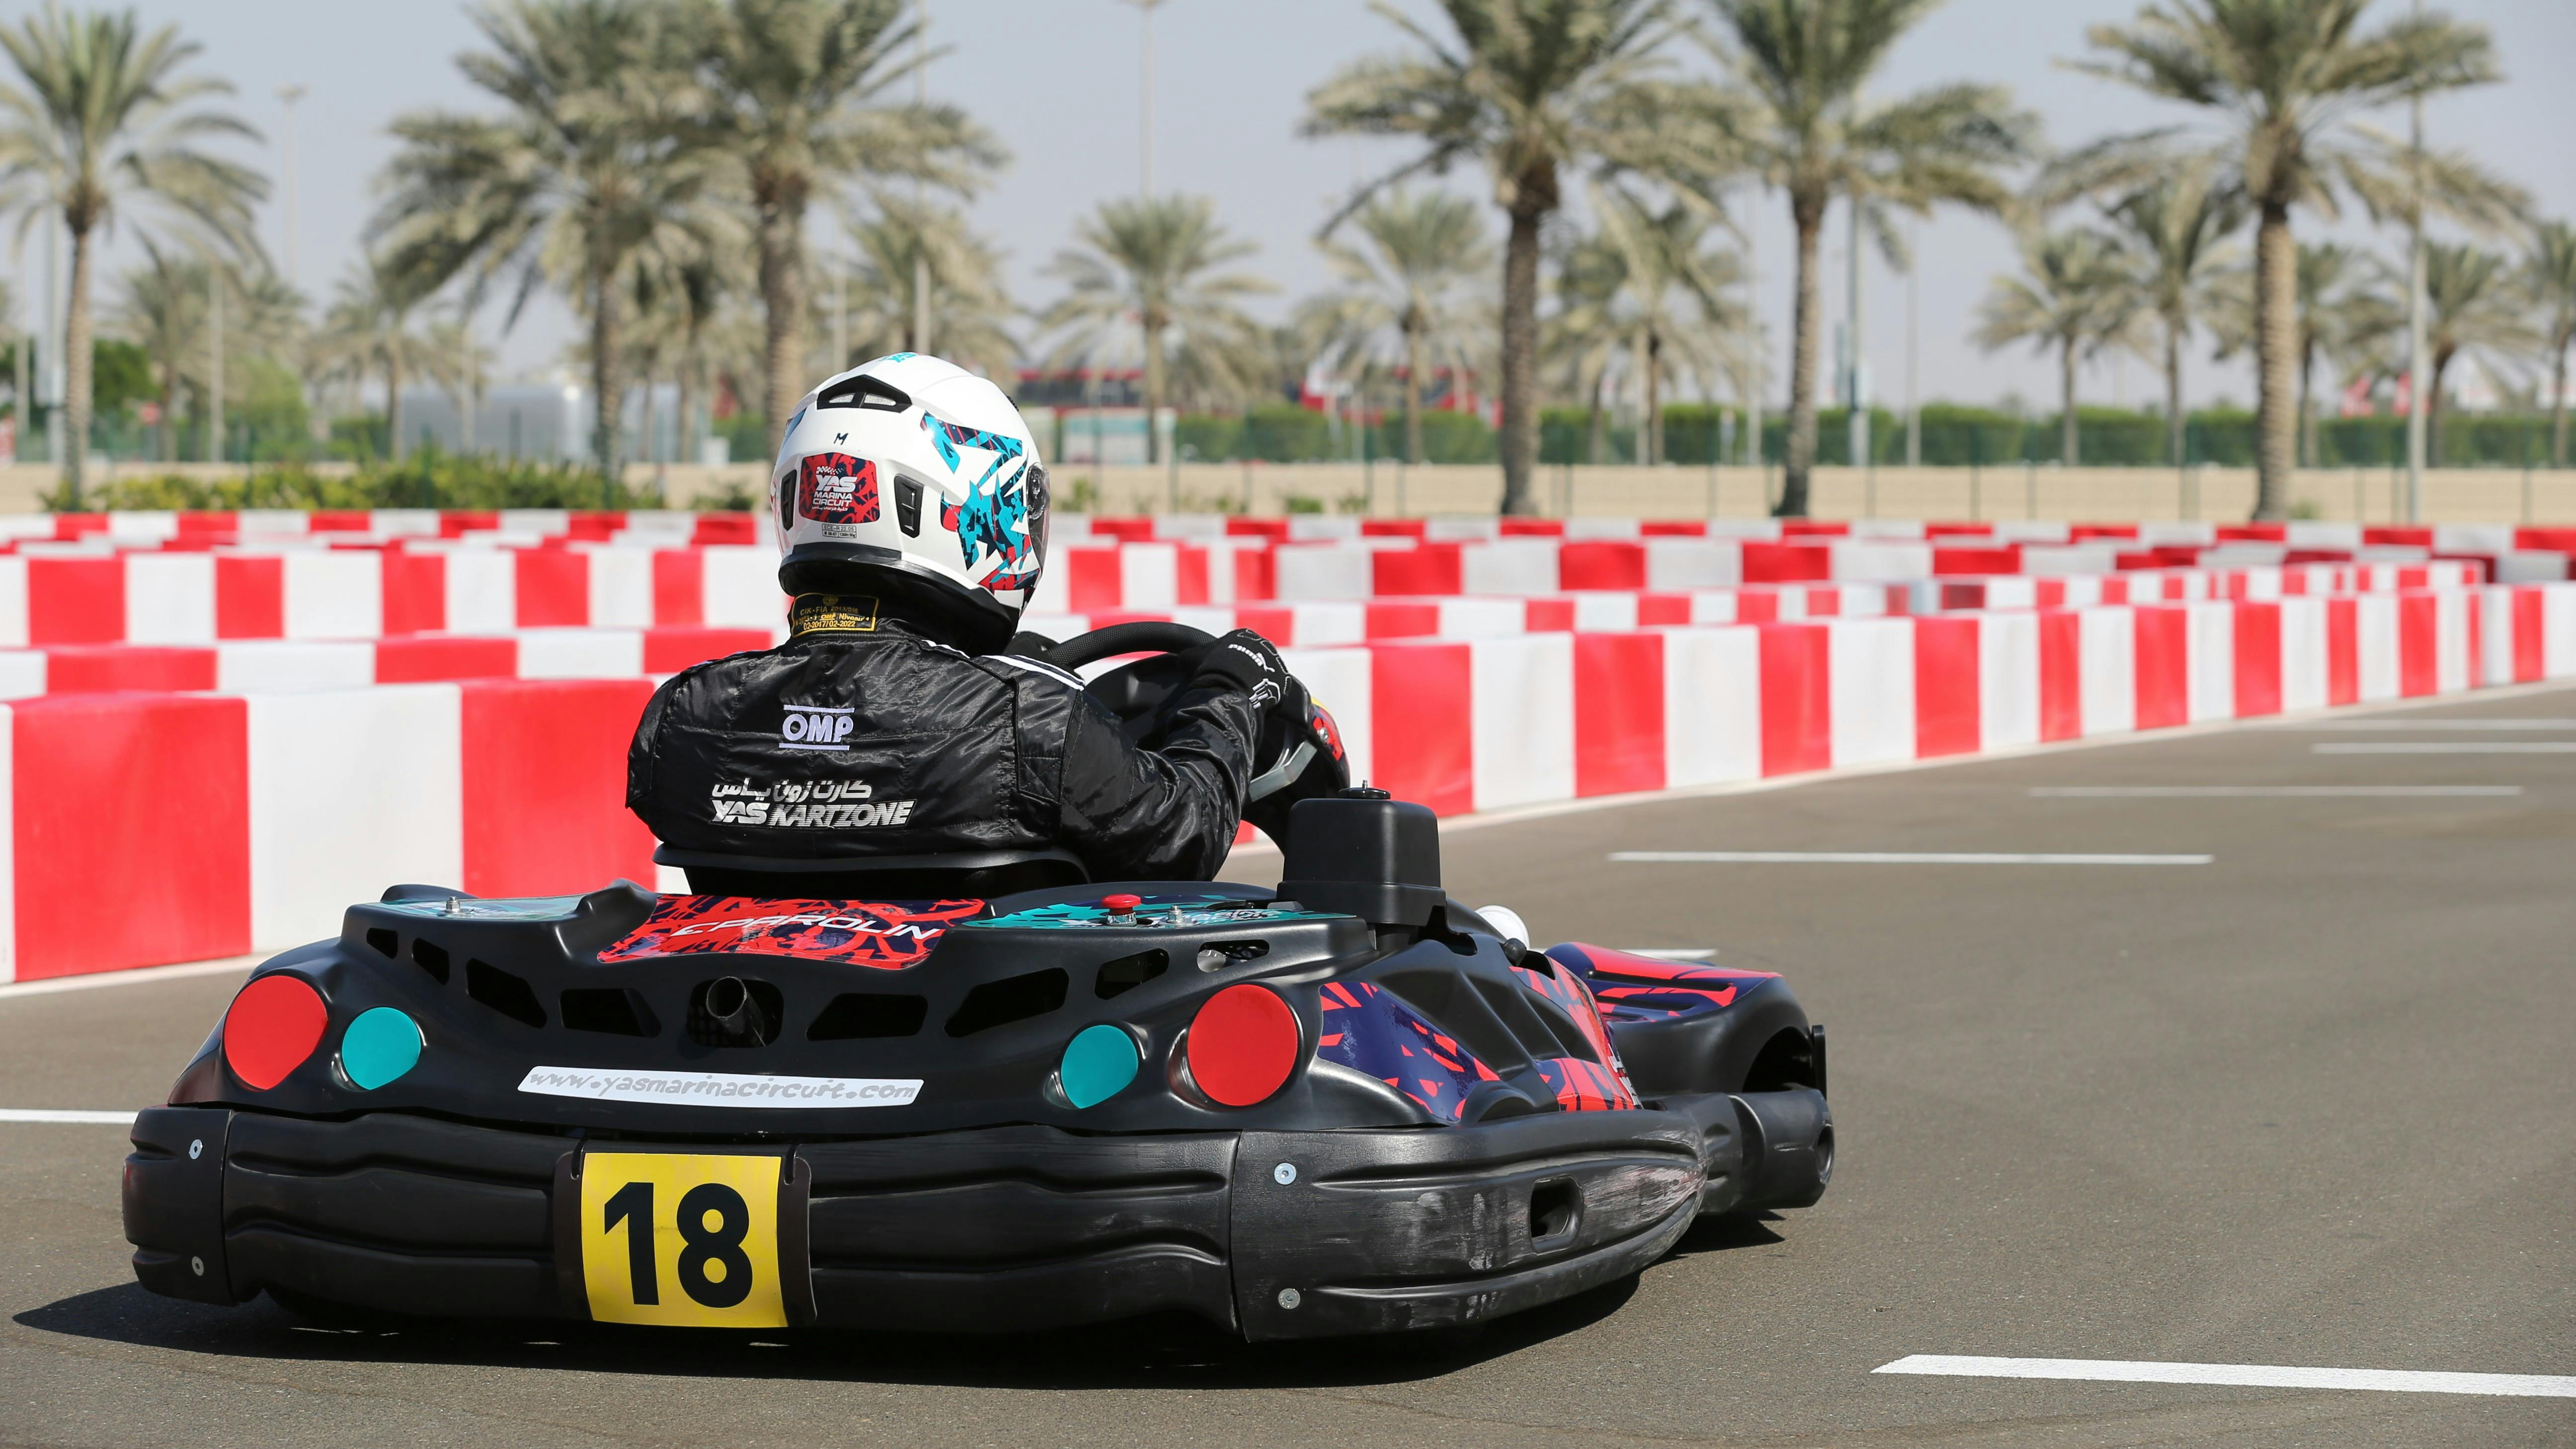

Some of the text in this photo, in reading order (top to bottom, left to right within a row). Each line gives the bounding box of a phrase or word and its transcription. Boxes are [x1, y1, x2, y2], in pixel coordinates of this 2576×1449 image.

[815, 475, 858, 492] YAS
[803, 620, 856, 631] 02-2017/02-2022
[782, 713, 854, 742] OMP
[773, 779, 814, 803] زون
[812, 779, 873, 801] كارت
[712, 800, 915, 827] YAS KARTZONE
[529, 1071, 917, 1100] www.yasmarinacircuit.com
[604, 1182, 753, 1308] 18
